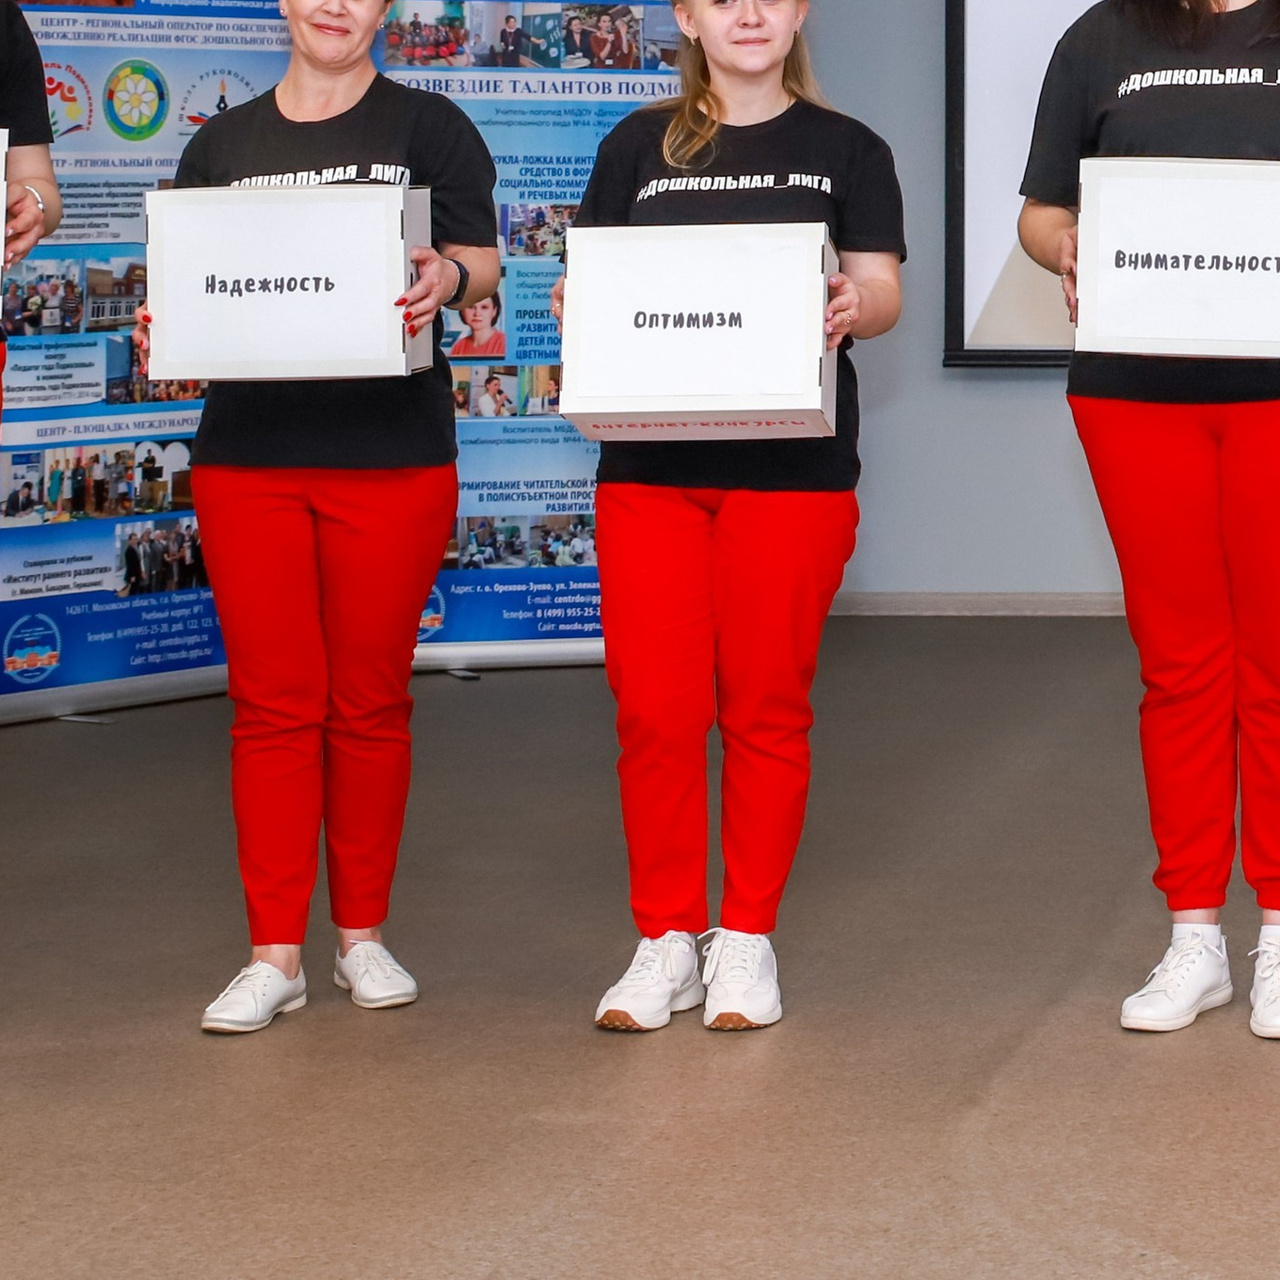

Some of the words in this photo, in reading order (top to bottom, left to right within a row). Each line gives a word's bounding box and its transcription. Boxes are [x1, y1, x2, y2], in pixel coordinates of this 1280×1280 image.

[41, 18, 79, 27] ЦЕНТР
[86, 19, 164, 29] РЕГИОНАЛЬНЫЙ
[167, 21, 213, 31] ОПЕРАТОР
[216, 23, 230, 31] ПО
[107, 33, 171, 43] РЕАЛИЗАЦИИ
[174, 34, 199, 43] ФГОС
[201, 36, 273, 45] ДОШКОЛЬНОГО
[509, 80, 613, 95] ТАЛАНТОВ
[75, 157, 152, 167] РЕГИОНАЛЬНЫЙ
[555, 156, 573, 165] КАК
[519, 167, 562, 177] СРЕДСТВО
[636, 173, 833, 203] #ДОШКОЛЬНАЯ_ЛИГА
[519, 190, 526, 199] И
[527, 190, 568, 200] РЕЧЕВЫХ
[205, 274, 336, 298] Надежность
[515, 309, 550, 319] ПРОЕКТ
[633, 311, 743, 330] Оптимизм
[517, 334, 545, 347] ДЕТЕЙ
[515, 349, 560, 359] ЦВЕТНЫМ
[36, 427, 67, 438] ЦЕНТР
[73, 422, 131, 435] ПЛОЩАДКА
[502, 420, 552, 433] Воспитатель
[459, 481, 521, 491] РМИРОВАНИЕ
[523, 478, 587, 489] ЧИТАТЕЛЬСКОЙ
[478, 493, 485, 502] В
[486, 491, 569, 502] ПОЛИСУБЪЕКТНОМ
[545, 502, 590, 512] РАЗВИТИЯ
